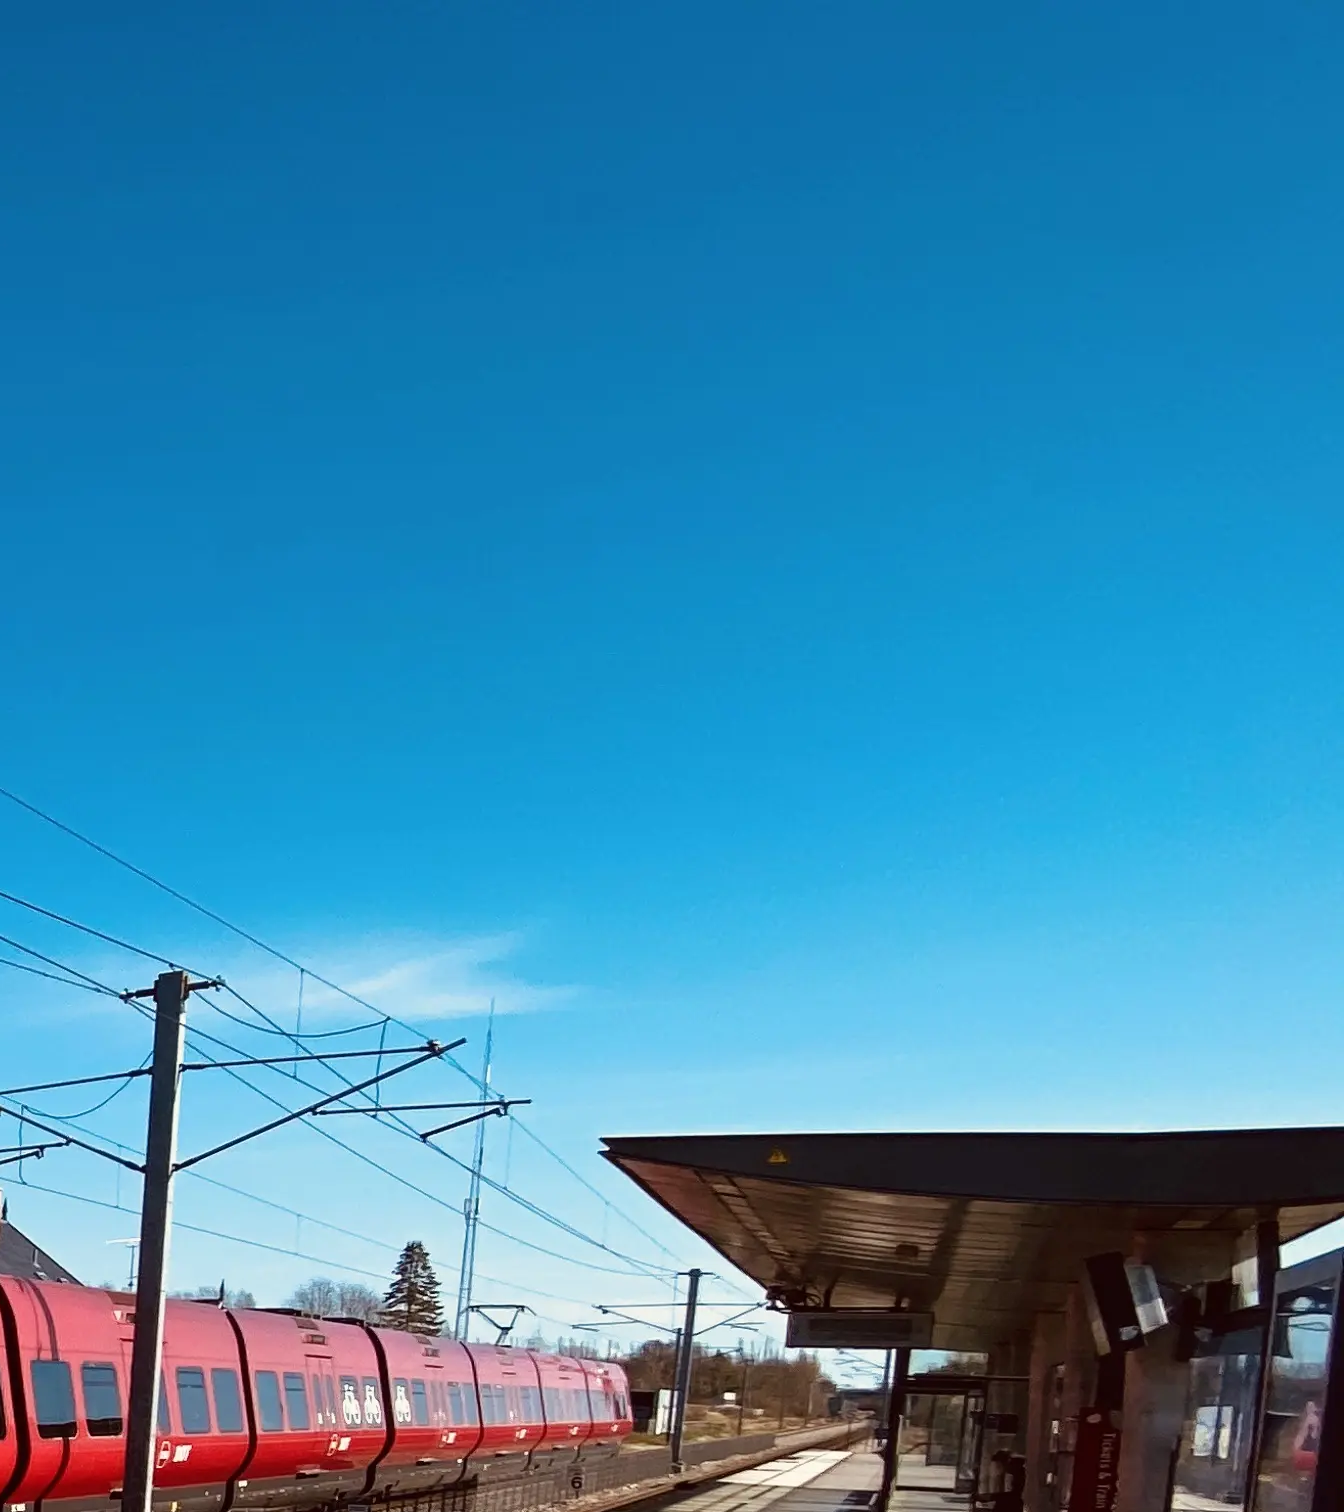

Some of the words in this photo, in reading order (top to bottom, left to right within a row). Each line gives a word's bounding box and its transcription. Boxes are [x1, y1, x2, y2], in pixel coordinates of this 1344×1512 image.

[1099, 1432, 1116, 1468] Tickets
[570, 1476, 582, 1490] 6
[1097, 1471, 1111, 1480] &
[1094, 1483, 1111, 1509] Train
